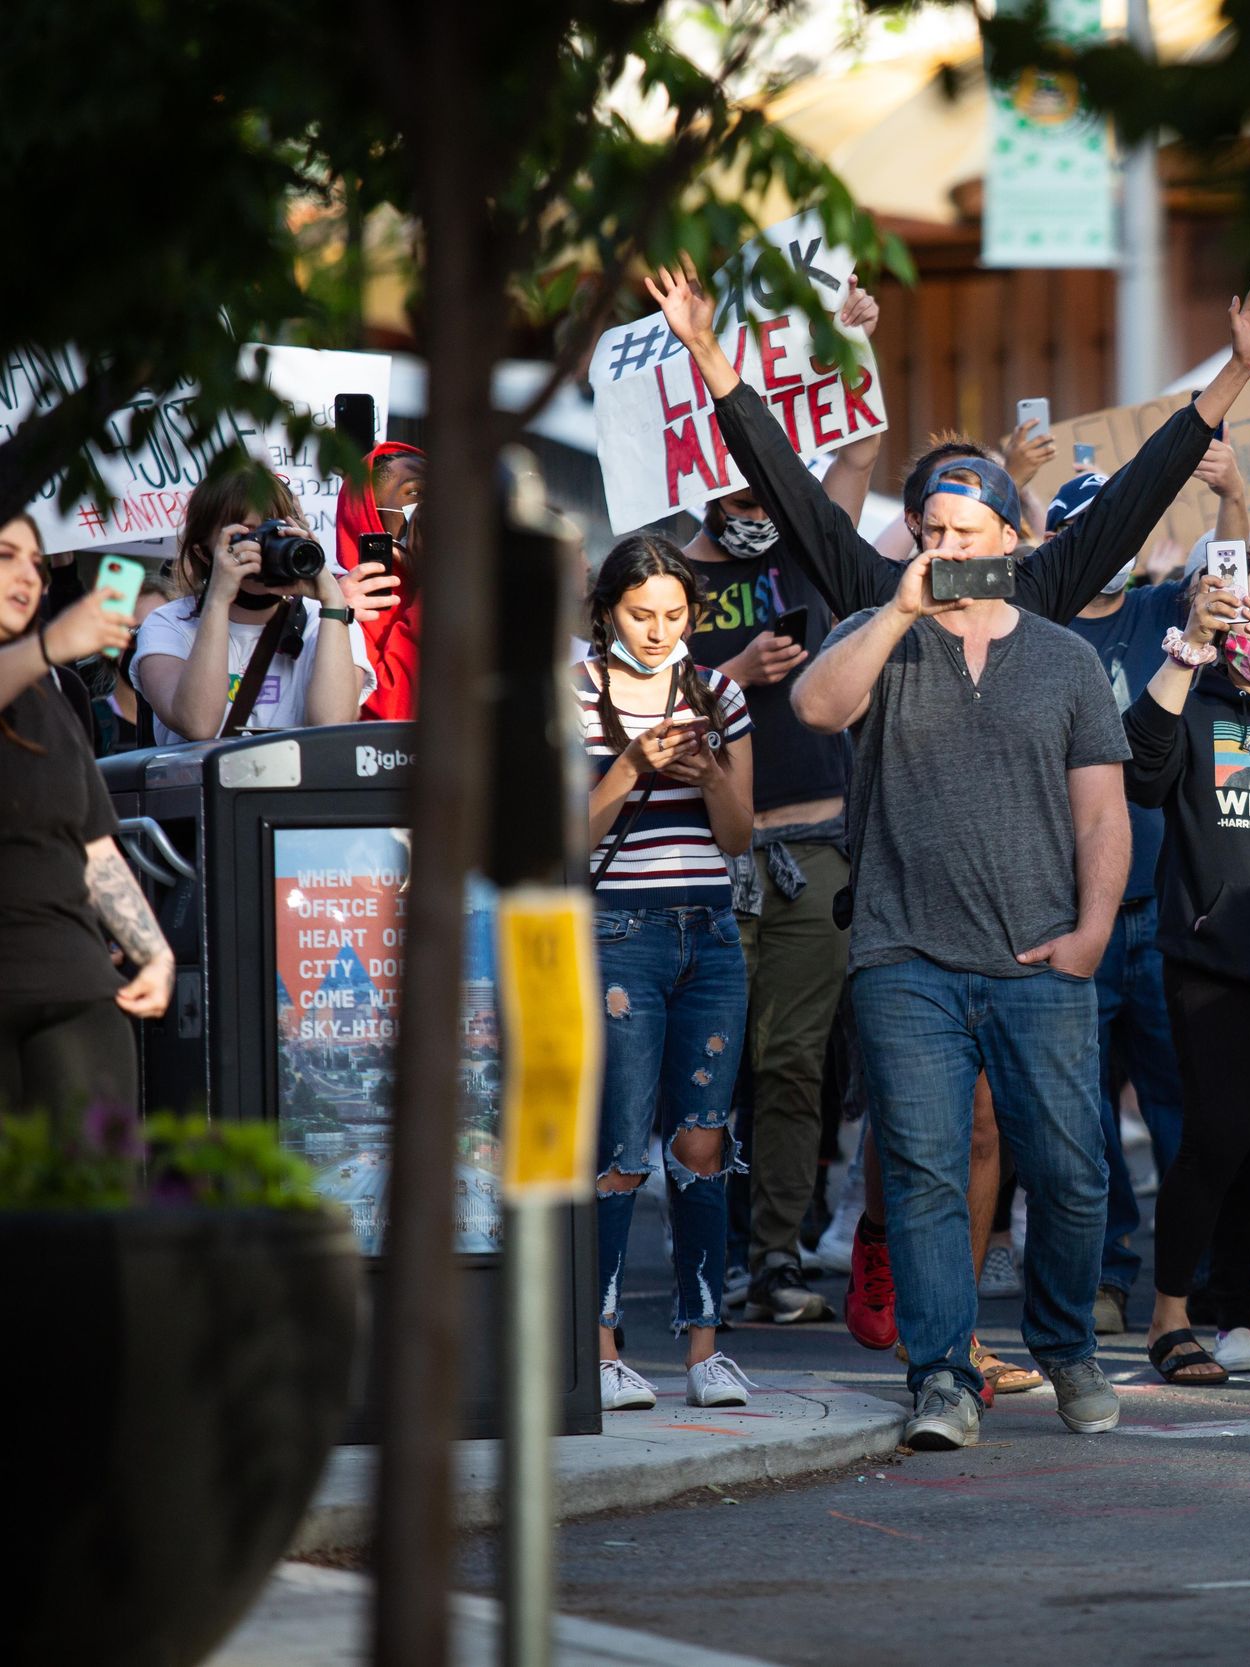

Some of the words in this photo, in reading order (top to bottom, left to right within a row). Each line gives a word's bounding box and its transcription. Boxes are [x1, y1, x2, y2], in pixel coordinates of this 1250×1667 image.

[663, 365, 884, 509] MATER
[694, 567, 786, 633] ESIST
[298, 868, 352, 888] WHEN
[298, 898, 379, 918] OFFICE
[298, 929, 368, 948] HEART
[299, 959, 355, 979] CITY
[300, 989, 356, 1009] COME
[300, 1019, 400, 1040] SKY-HIG
